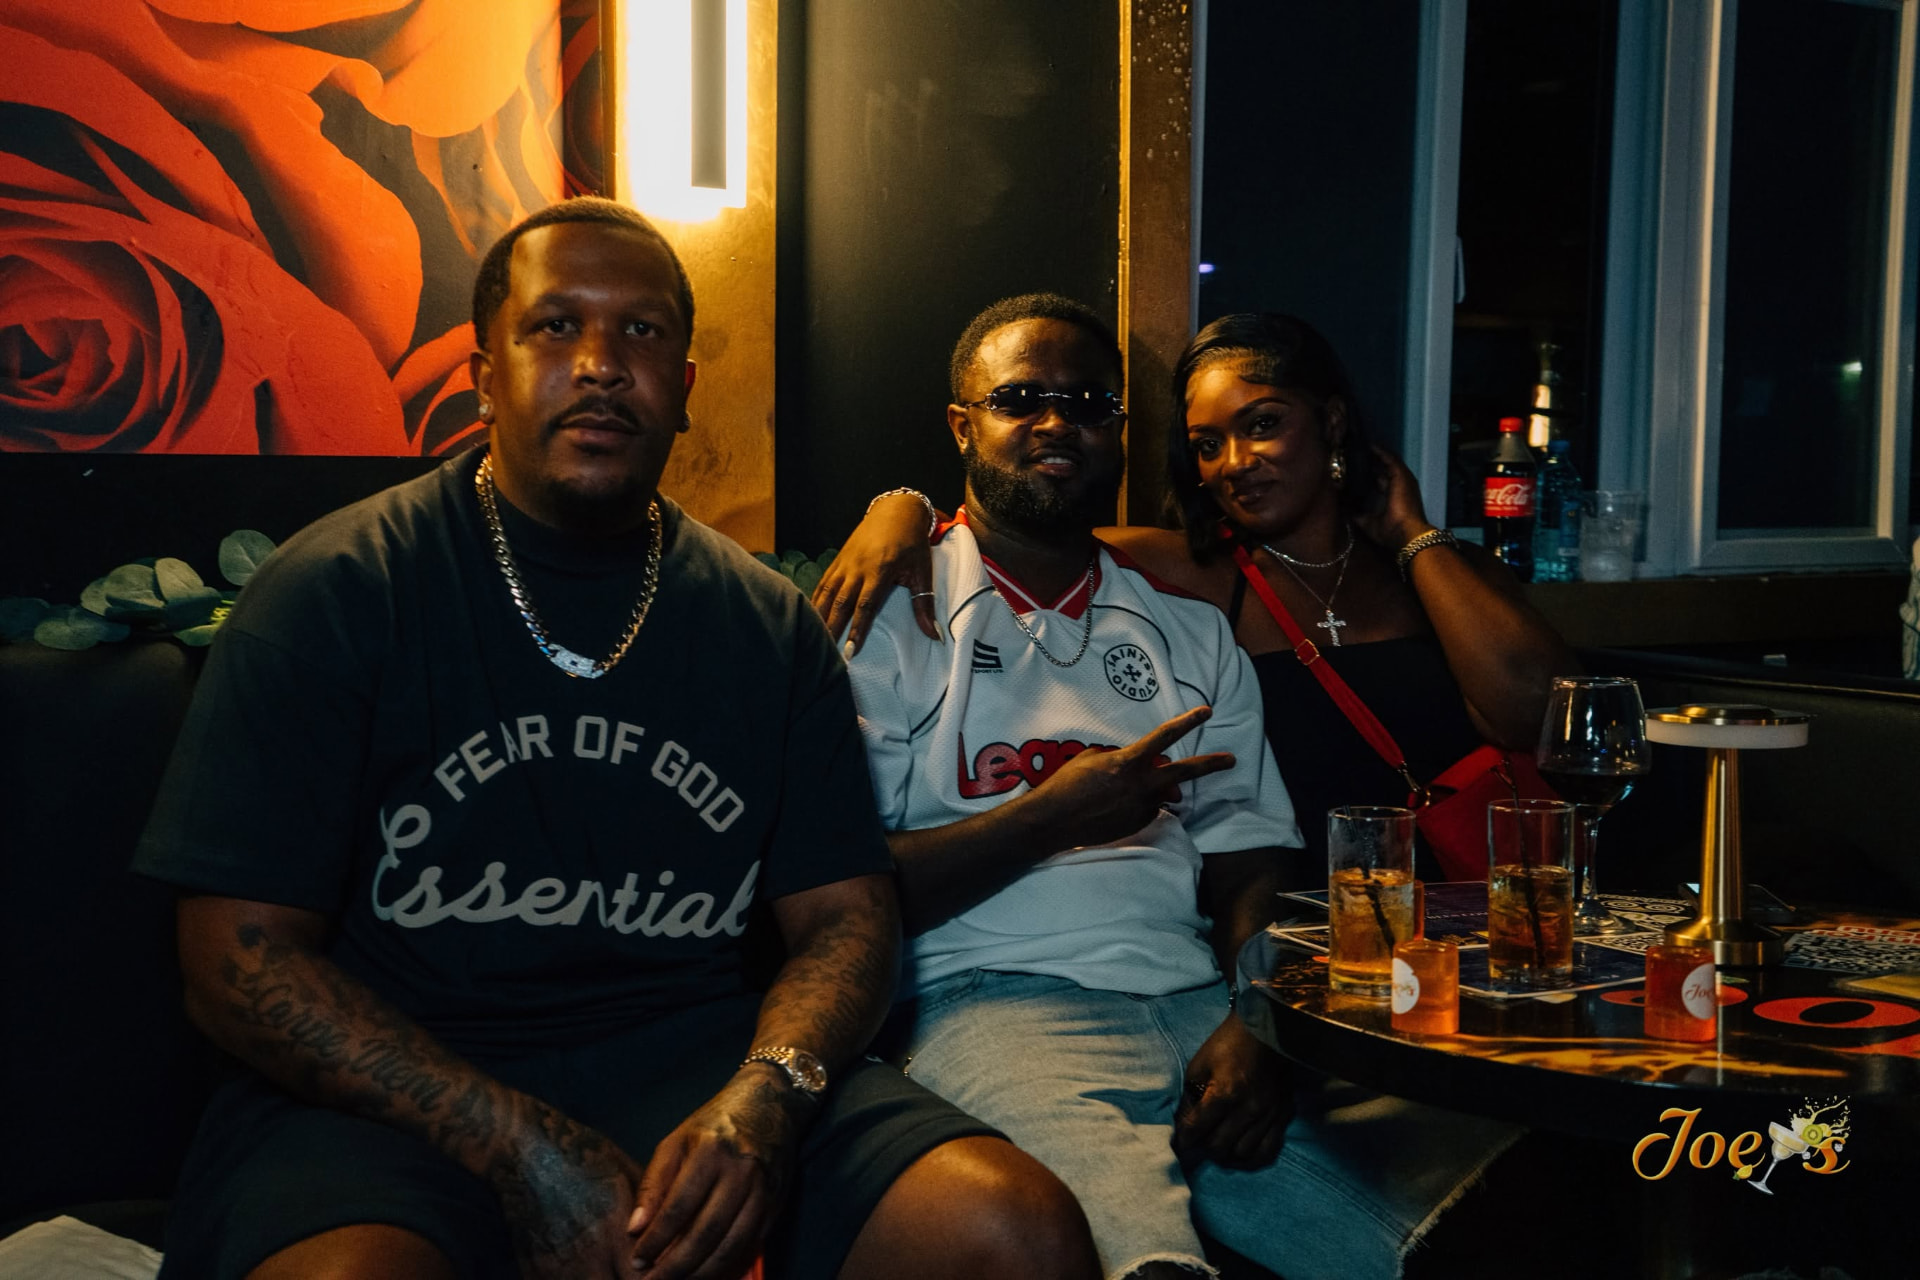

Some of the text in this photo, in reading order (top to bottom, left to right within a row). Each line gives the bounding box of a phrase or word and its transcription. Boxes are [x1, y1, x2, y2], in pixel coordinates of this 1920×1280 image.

[1107, 648, 1151, 671] SAINTS
[1112, 675, 1156, 698] STUDIO
[433, 714, 745, 833] FEAR OF GOD
